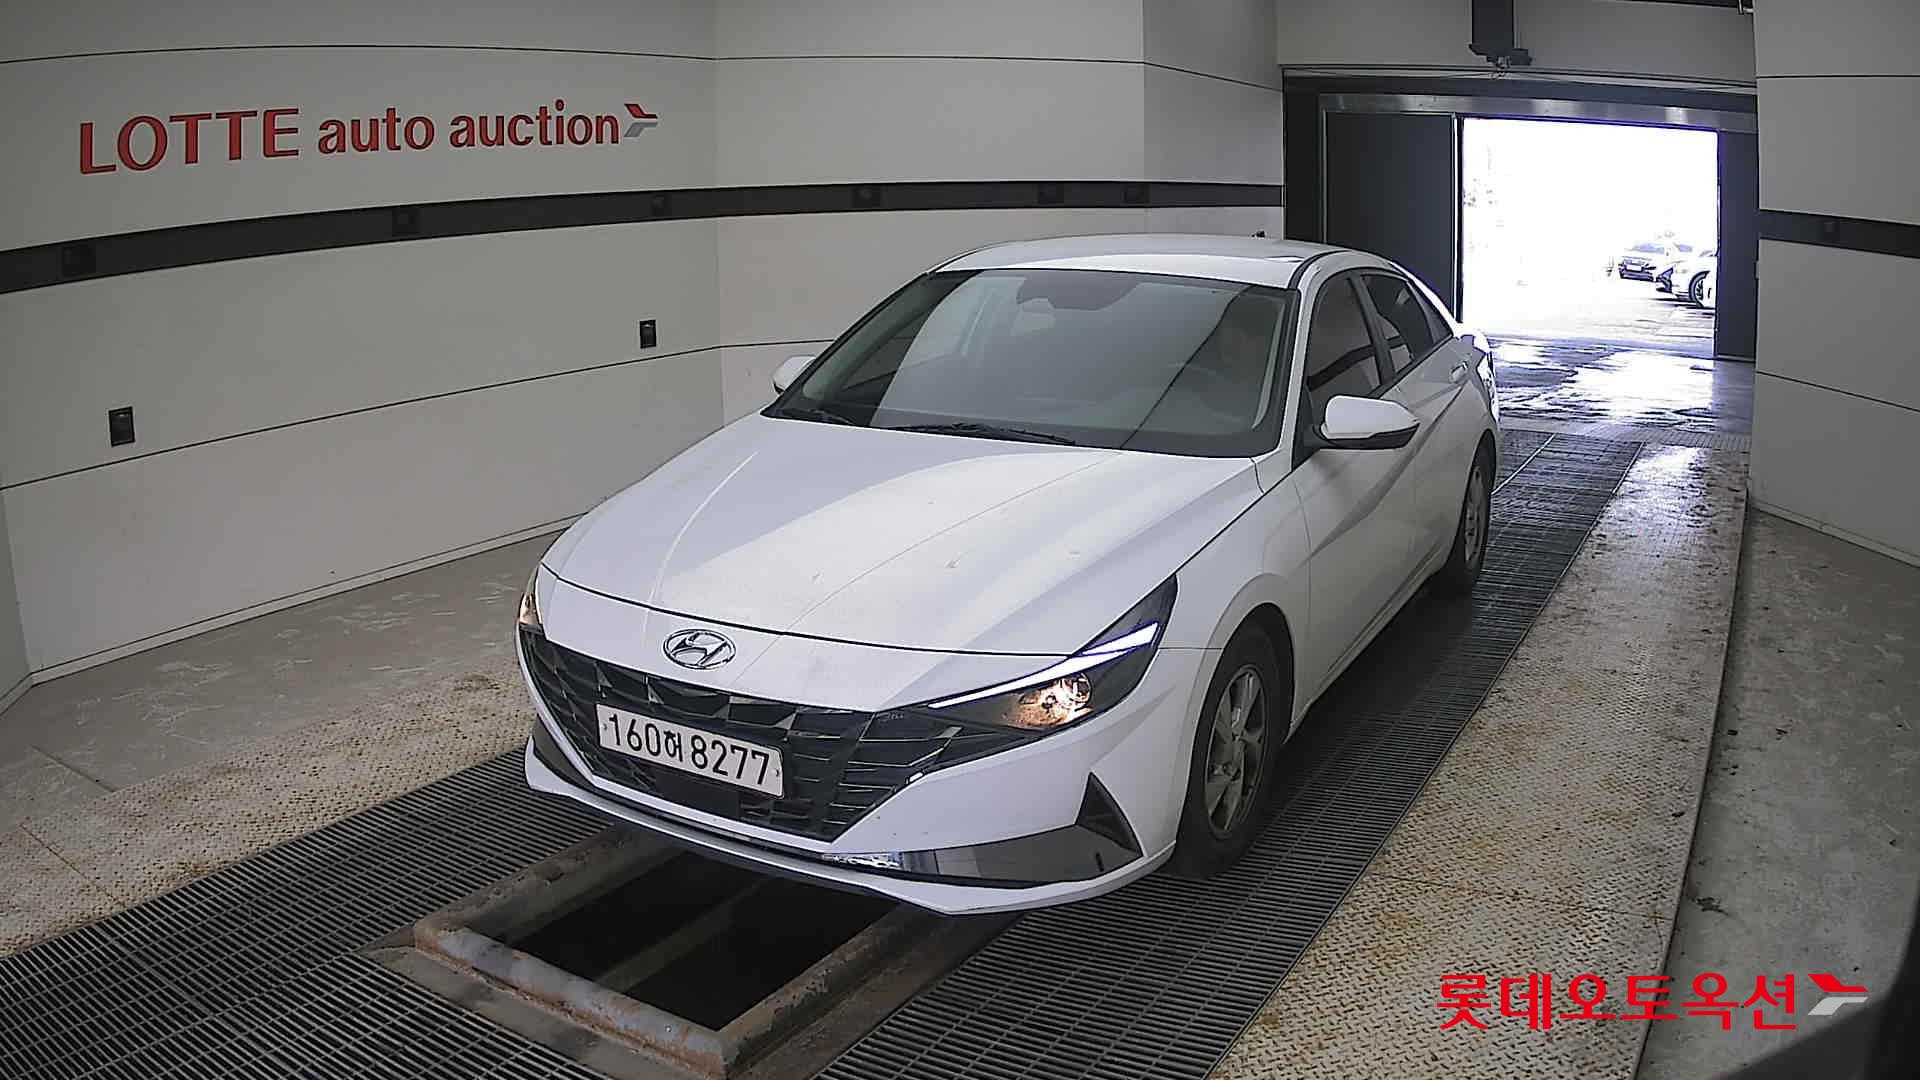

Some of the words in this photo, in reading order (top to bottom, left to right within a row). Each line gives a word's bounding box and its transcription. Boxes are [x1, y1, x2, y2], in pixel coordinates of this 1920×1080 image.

[80, 108, 299, 174] LOTTE
[318, 107, 436, 155] auto
[448, 99, 621, 147] auction
